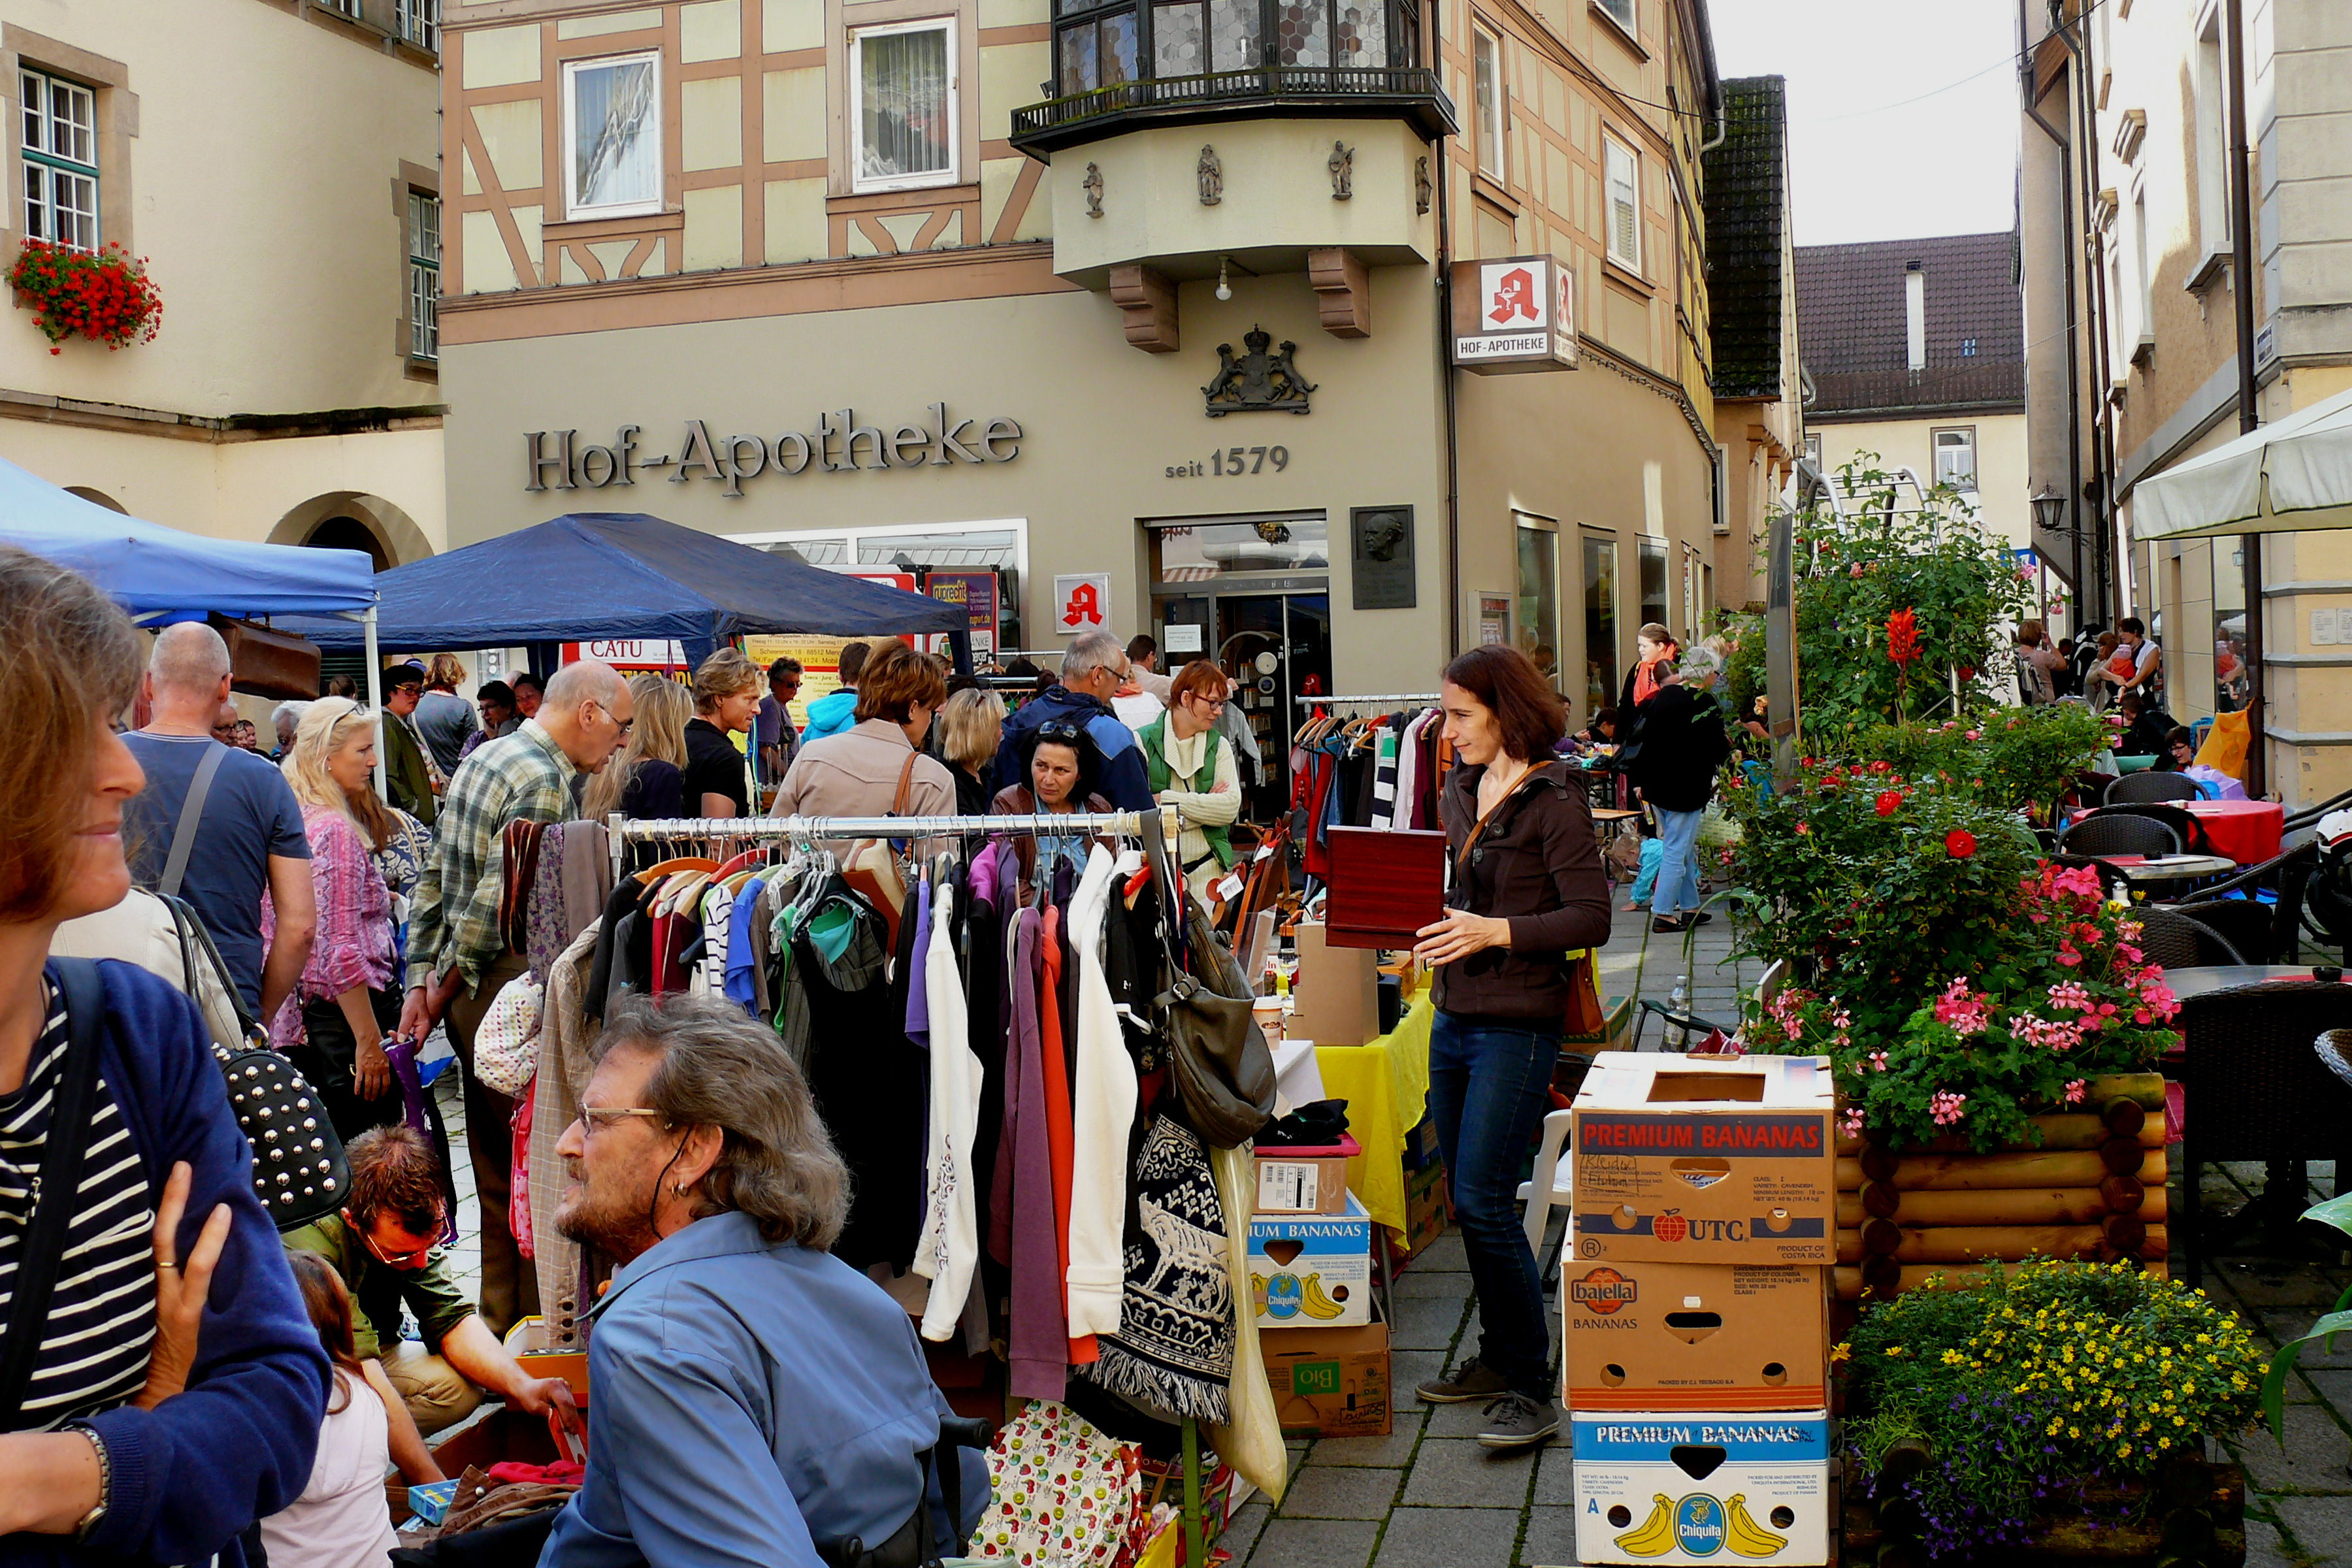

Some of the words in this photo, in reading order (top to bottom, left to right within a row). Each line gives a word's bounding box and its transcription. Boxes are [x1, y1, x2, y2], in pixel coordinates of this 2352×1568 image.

[1460, 337, 1544, 353] HOF-APOTHEKE
[523, 401, 1024, 498] Hof-Apotheke
[1165, 461, 1203, 478] seit
[1211, 445, 1289, 476] 1579
[1584, 1123, 1693, 1148] PREMIUM
[1702, 1124, 1820, 1149] BANANAS
[1289, 1224, 1362, 1237] BANANAS
[1688, 1219, 1744, 1242] UTC
[1576, 1283, 1633, 1303] bajella
[1134, 1309, 1194, 1343] ROMA
[1573, 1318, 1637, 1330] BANANAS
[1597, 1426, 1691, 1443] PREMIUM
[1702, 1426, 1800, 1443] BANANAS
[1587, 1497, 1599, 1514] A
[1679, 1524, 1722, 1539] Chiquita
